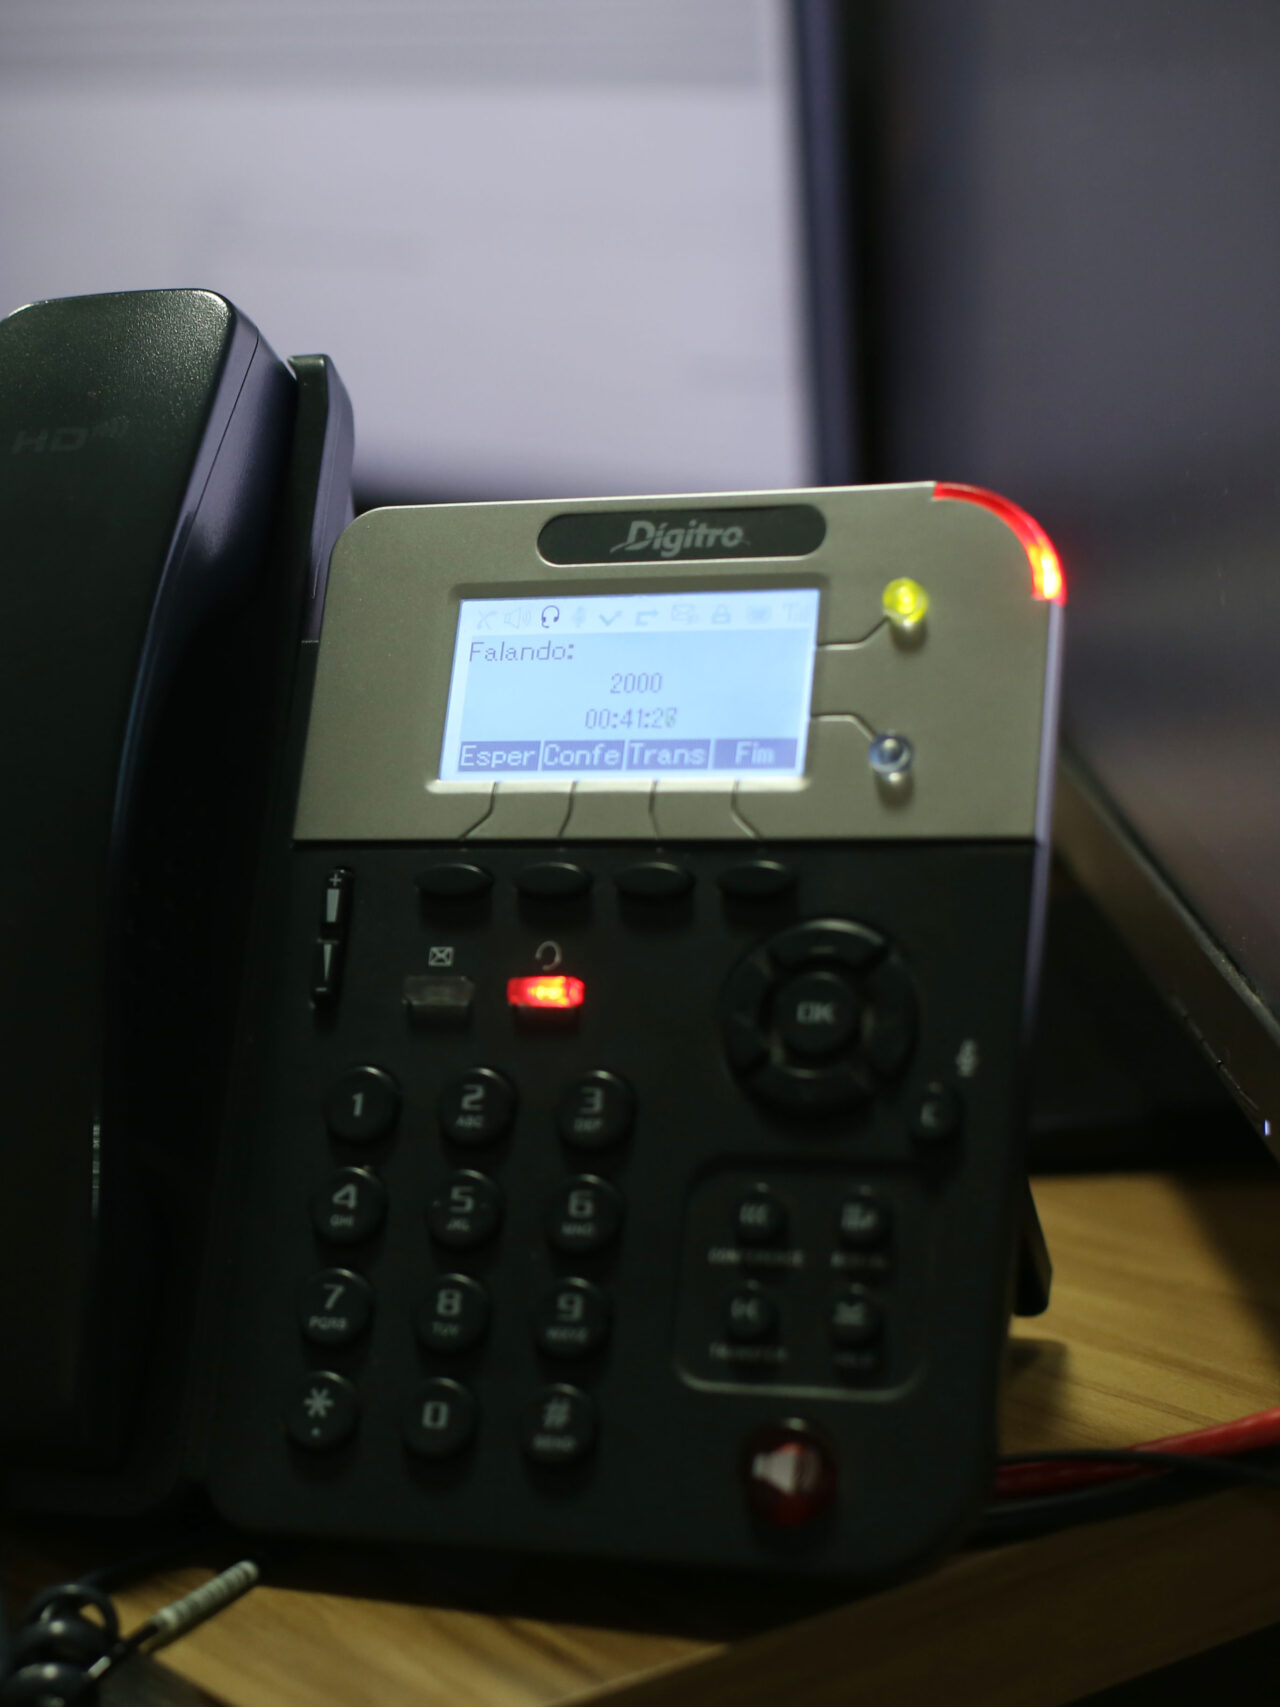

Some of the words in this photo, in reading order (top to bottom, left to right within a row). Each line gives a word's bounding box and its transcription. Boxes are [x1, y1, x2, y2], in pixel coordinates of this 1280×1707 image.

[469, 640, 575, 662] Falando:
[609, 672, 663, 694] 2000
[460, 745, 536, 768] Esper
[543, 743, 620, 767] Confe
[629, 742, 705, 766] Trans
[734, 741, 775, 765] Fim
[351, 1091, 365, 1118] 1
[460, 1083, 486, 1112] 2
[578, 1086, 605, 1115] 3
[331, 1183, 359, 1211] 4
[449, 1186, 476, 1215] 5
[567, 1190, 595, 1219] 6
[323, 1283, 347, 1311] 7
[435, 1288, 463, 1317] 8
[556, 1292, 586, 1323] 9
[421, 1400, 450, 1430] 0
